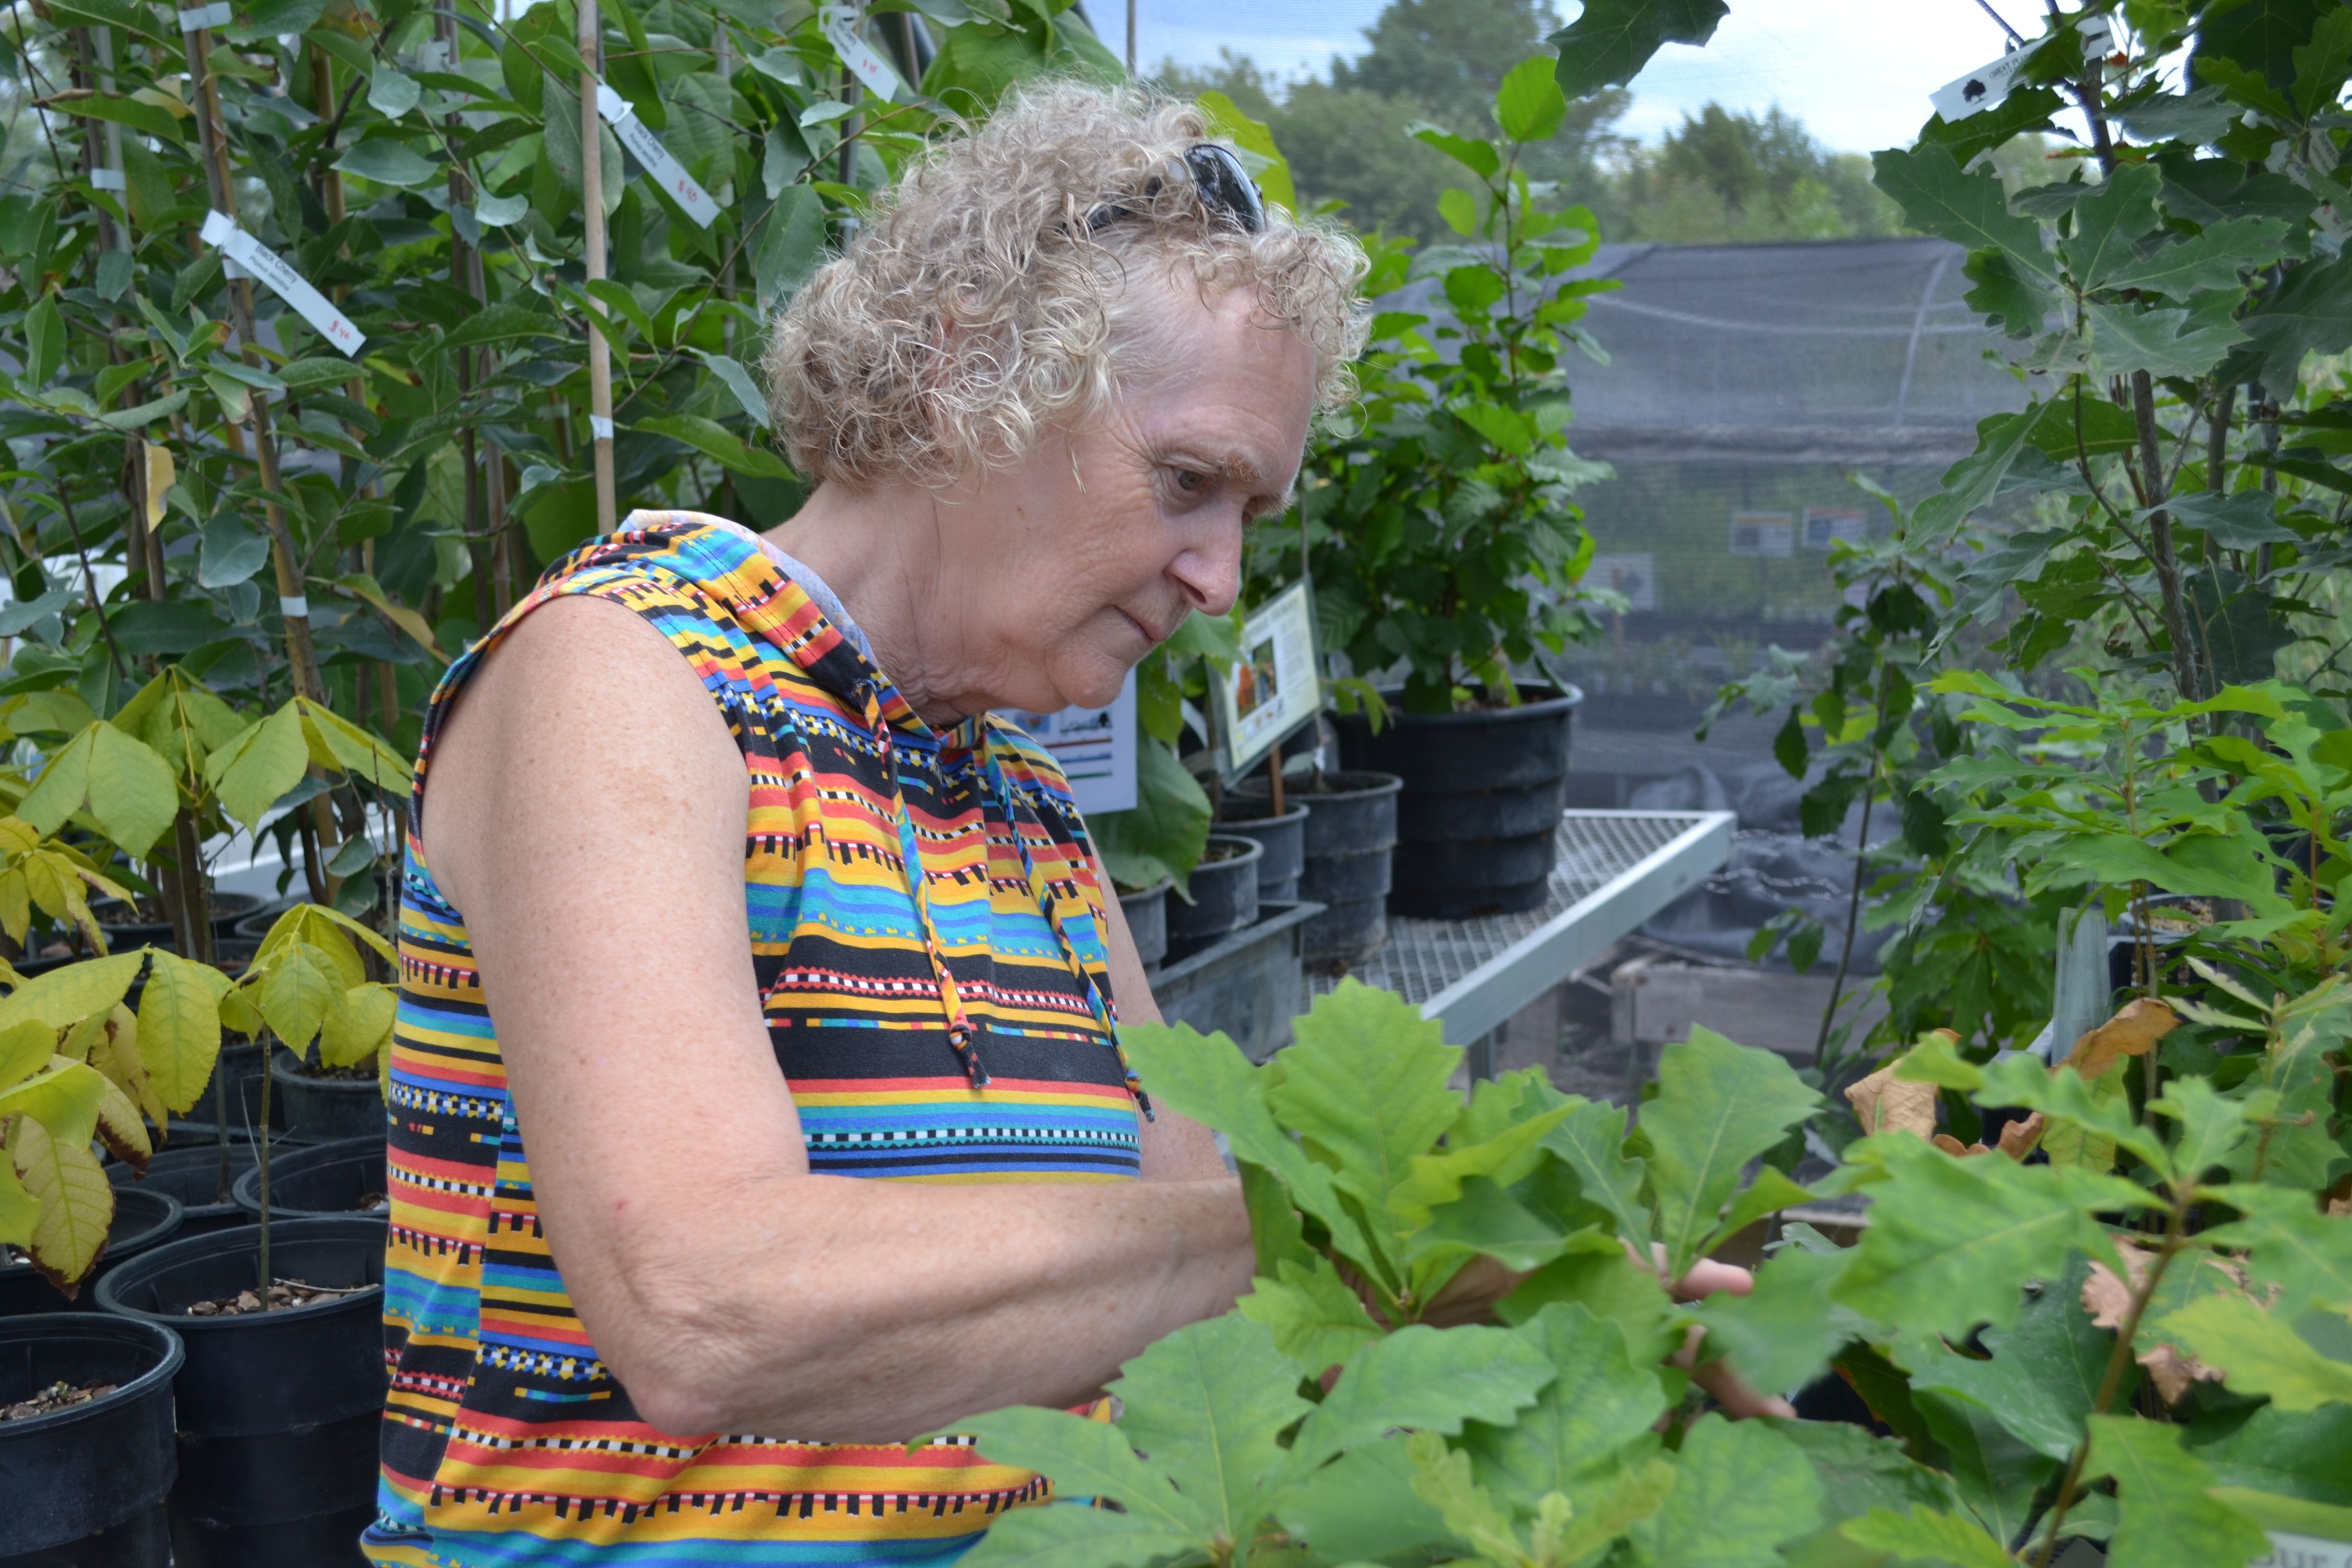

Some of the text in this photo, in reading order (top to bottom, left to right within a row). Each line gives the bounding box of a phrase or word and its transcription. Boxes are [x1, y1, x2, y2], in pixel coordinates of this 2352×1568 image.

[1989, 62, 2011, 79] GREAT
[647, 137, 665, 160] Cherry
[255, 244, 299, 284] Black Cherry
